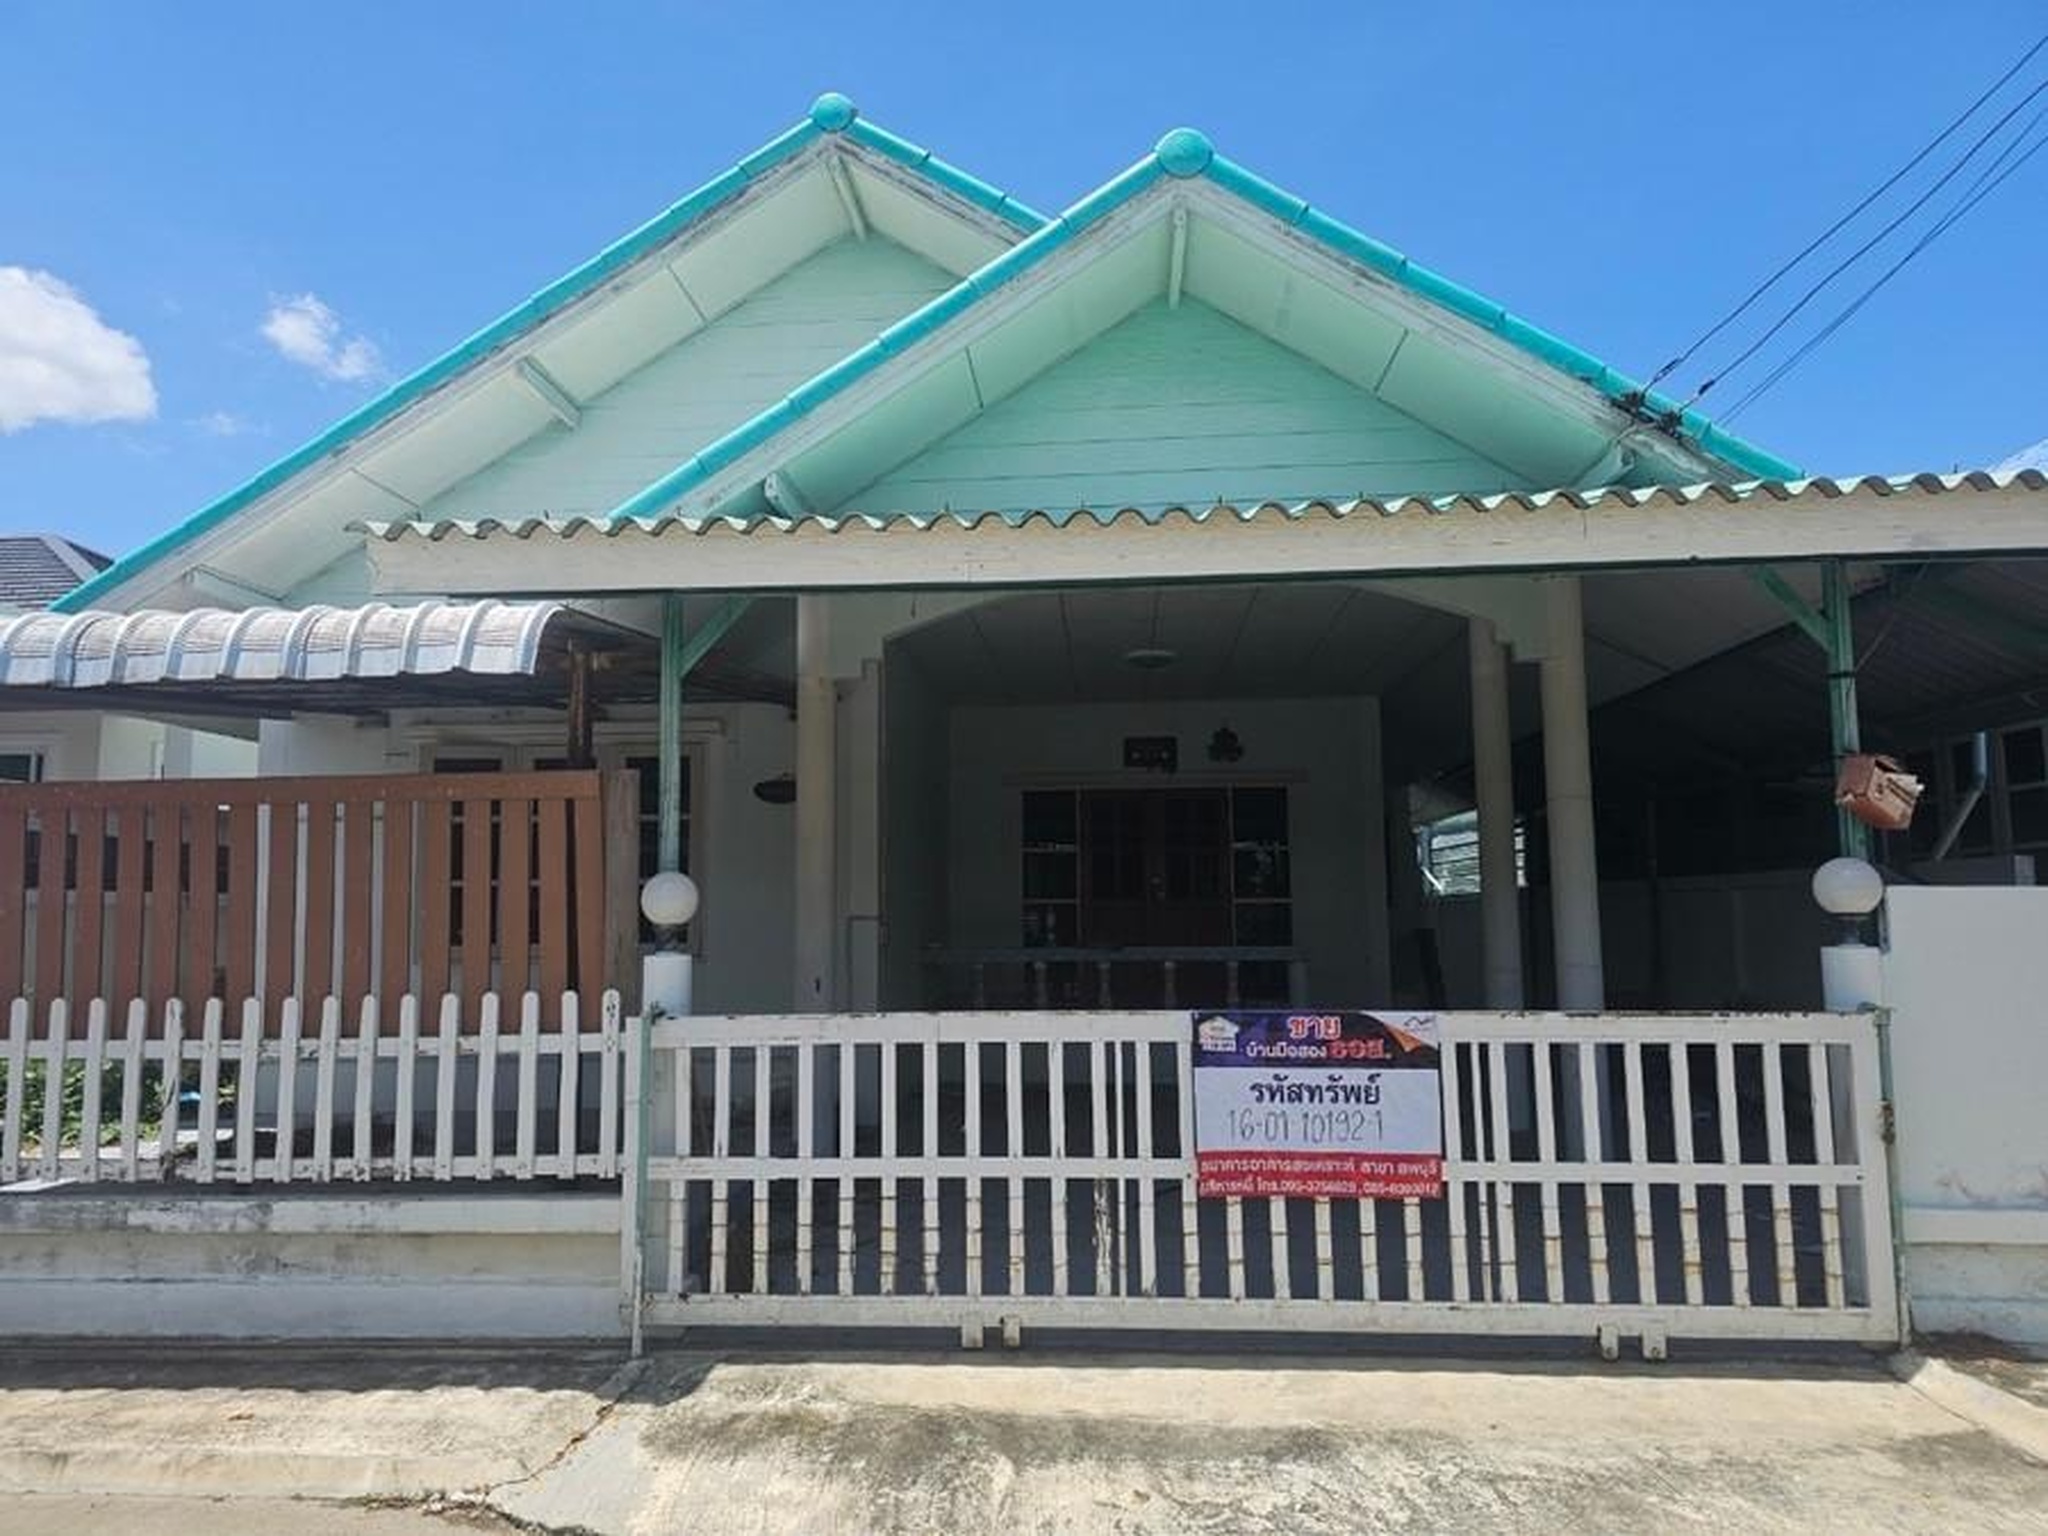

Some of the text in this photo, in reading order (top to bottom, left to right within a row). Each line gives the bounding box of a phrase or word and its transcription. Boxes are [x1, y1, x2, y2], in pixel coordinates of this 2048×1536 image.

[1287, 1015, 1341, 1040] ขาย
[1246, 1041, 1327, 1059] บ้านมือสอง
[1250, 1073, 1381, 1105] รหัสทรัพย์
